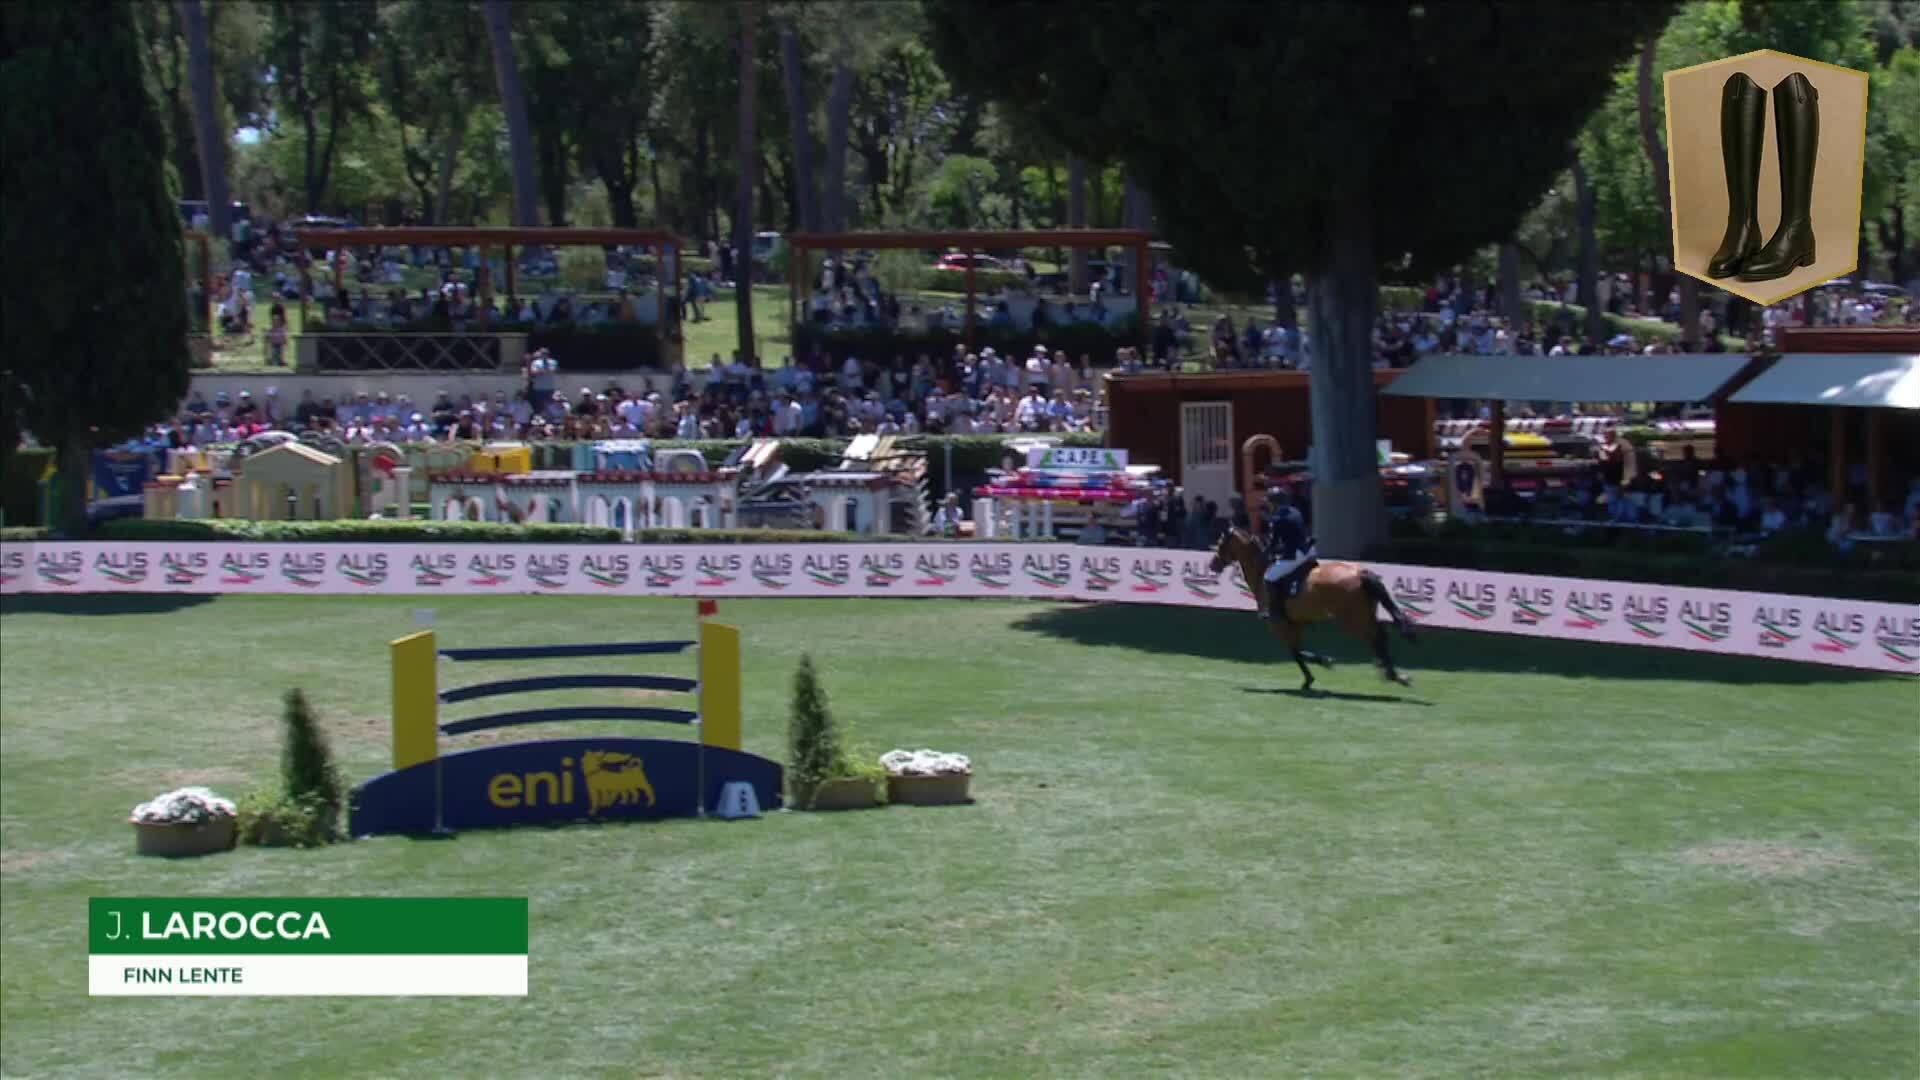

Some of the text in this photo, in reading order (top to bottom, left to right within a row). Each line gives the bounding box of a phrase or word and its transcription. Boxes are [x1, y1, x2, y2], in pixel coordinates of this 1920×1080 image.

[35, 552, 82, 568] ALIS
[94, 552, 148, 568] ALIS
[160, 552, 207, 567] ALIS
[220, 552, 269, 568] ALIS
[280, 552, 326, 567] ALIS
[336, 553, 388, 570] ALIS
[410, 554, 457, 569] ALIS
[468, 554, 515, 570] ALIS
[526, 554, 569, 570] ALIS
[580, 554, 629, 571] ALIS
[640, 555, 684, 570] ALIS
[697, 554, 742, 570] ALIS
[752, 554, 792, 569] ALIS
[803, 554, 849, 571] ALIS
[860, 554, 904, 569] ALIS
[915, 553, 960, 569] ALIS
[969, 553, 1012, 569] ALIS
[1022, 554, 1071, 571] ALIS
[1080, 556, 1120, 573] ALIS
[1131, 559, 1172, 576] ALIS
[1392, 577, 1435, 595] ALIS
[1447, 581, 1496, 602] ALIS
[1507, 586, 1553, 605] ALIS
[1566, 591, 1613, 611] ALIS
[1623, 594, 1668, 616] ALIS
[1678, 600, 1731, 622] ALIS
[1753, 606, 1801, 627] ALIS
[1813, 611, 1864, 633] ALIS
[489, 757, 574, 808] eni
